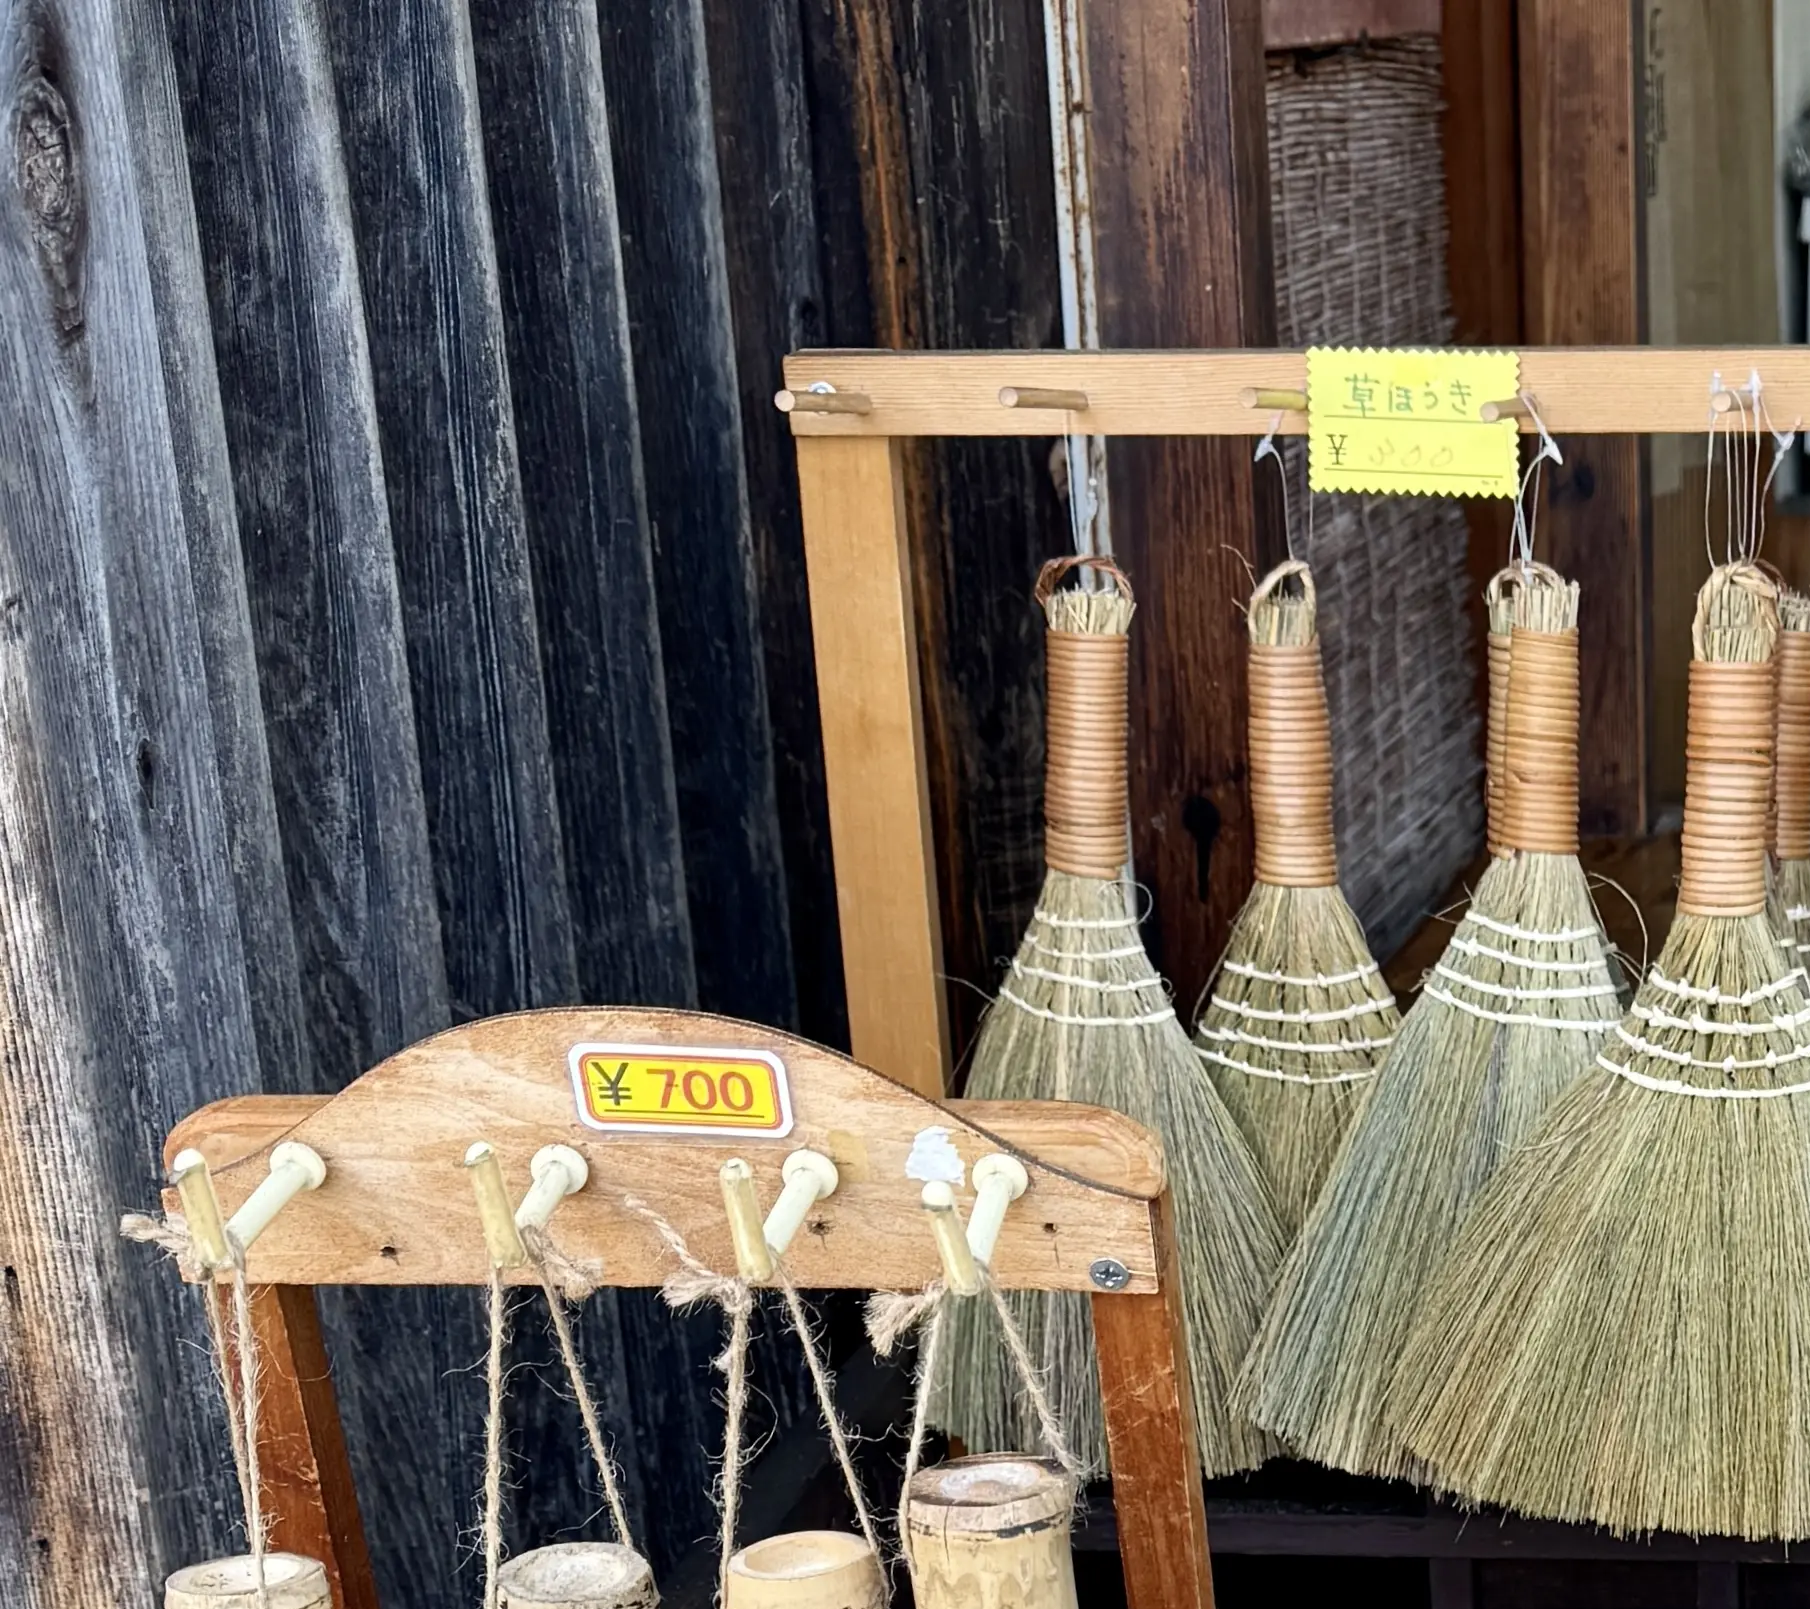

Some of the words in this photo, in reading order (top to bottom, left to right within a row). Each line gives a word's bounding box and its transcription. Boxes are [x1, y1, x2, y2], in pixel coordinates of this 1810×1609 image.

[1342, 372, 1473, 419] 草ほうき
[646, 1068, 754, 1112] 700
